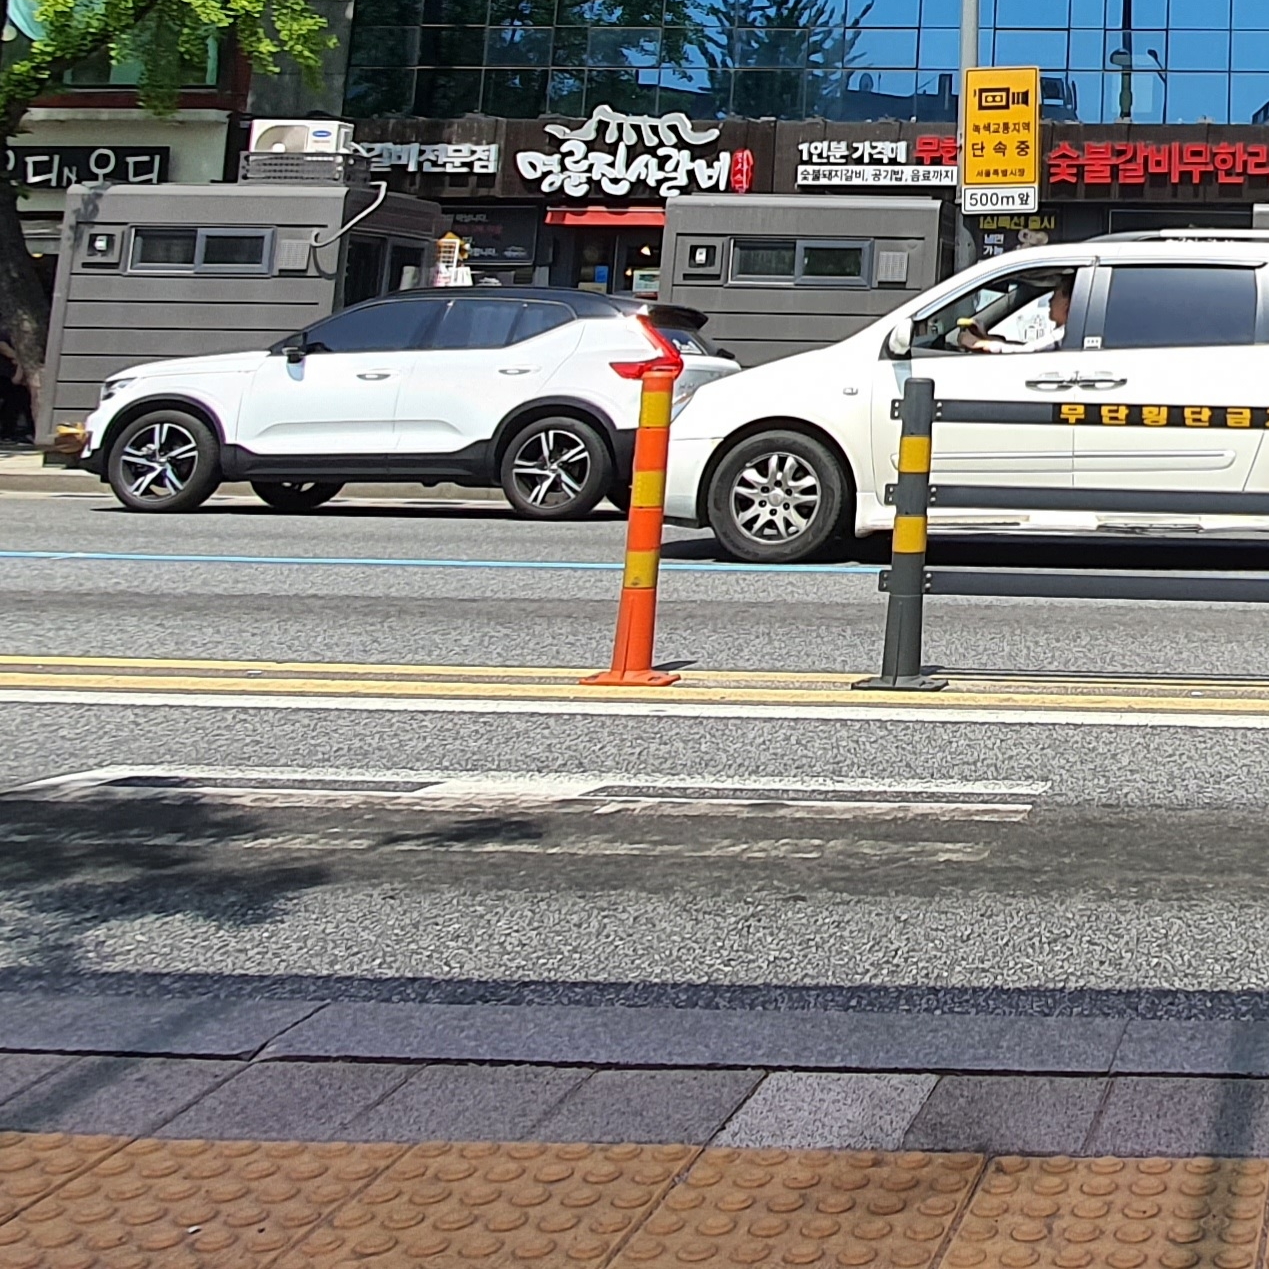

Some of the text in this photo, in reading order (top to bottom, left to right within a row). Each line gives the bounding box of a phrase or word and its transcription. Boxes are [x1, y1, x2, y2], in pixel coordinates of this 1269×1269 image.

[972, 121, 1031, 135] 녹색교통지역
[798, 140, 849, 164] 1인분
[516, 139, 731, 197] 명륜진사갈비
[910, 168, 954, 182] 음료까지
